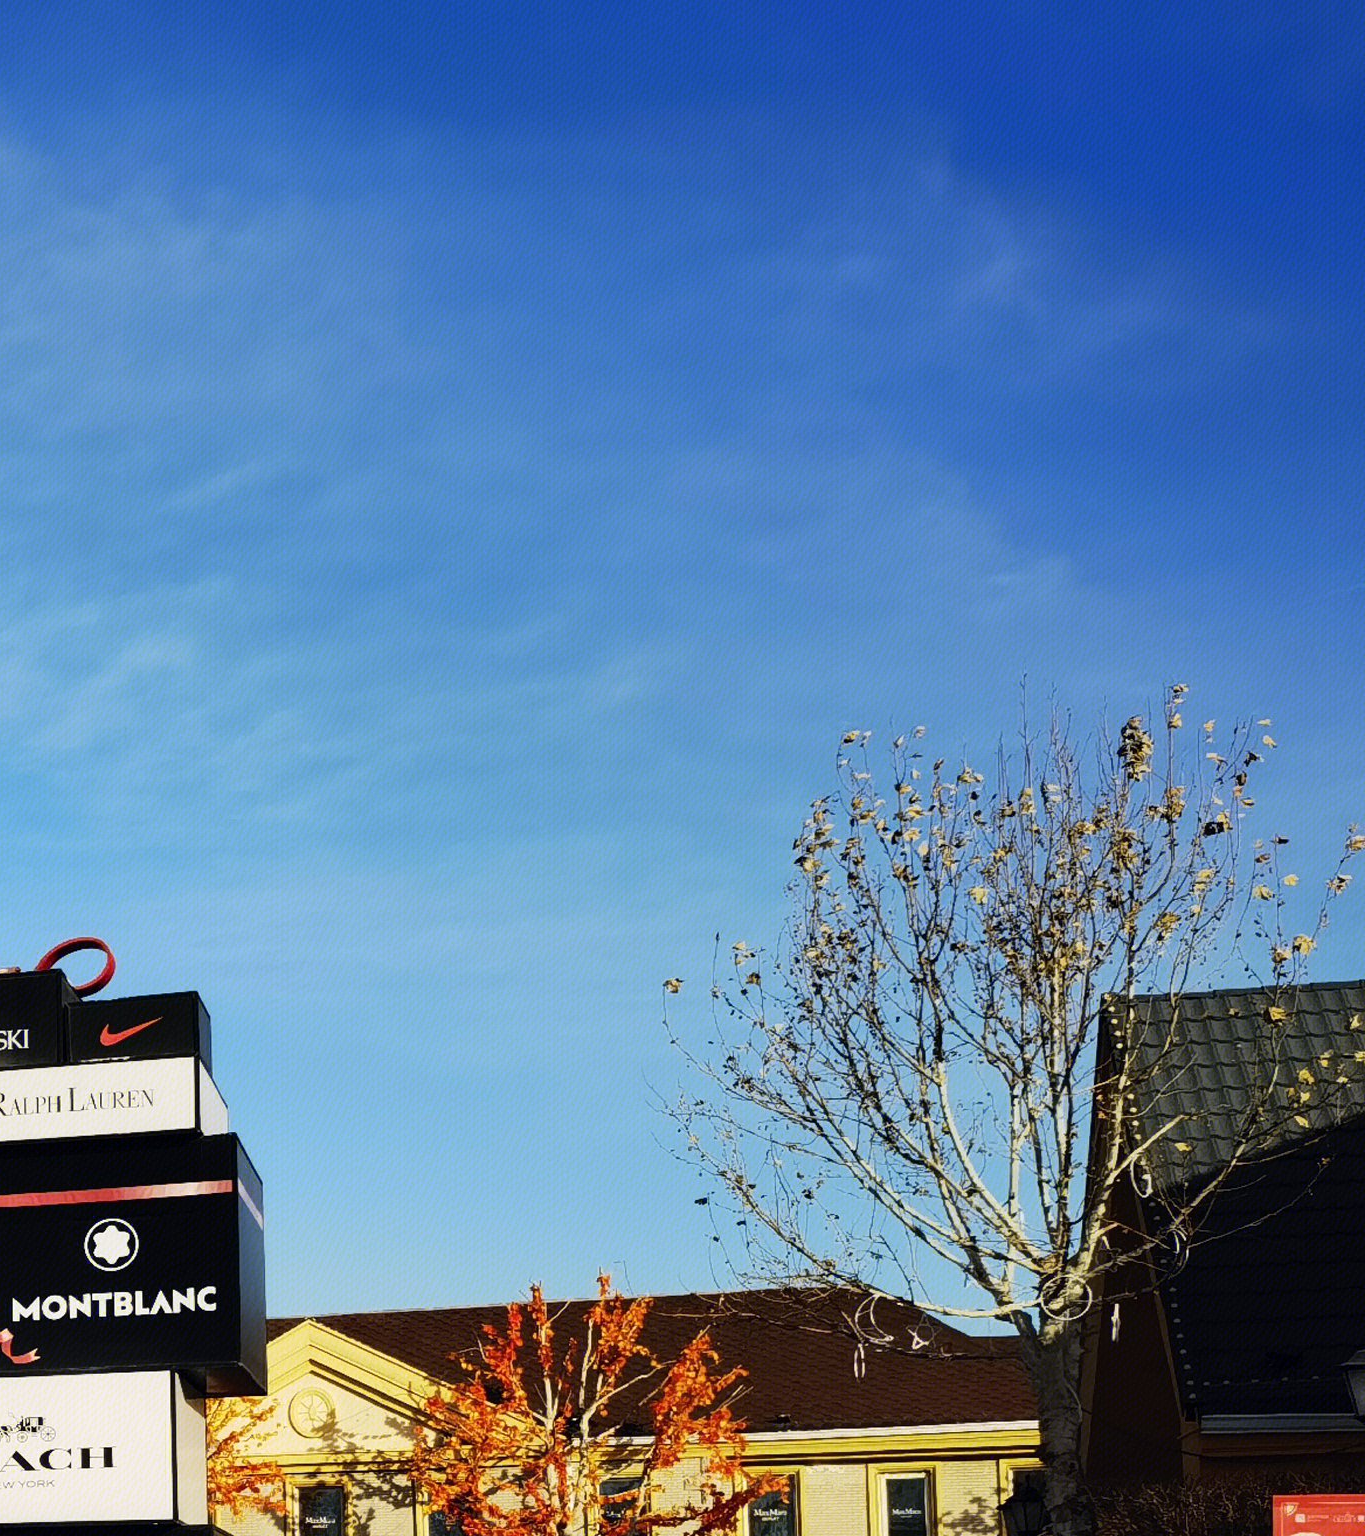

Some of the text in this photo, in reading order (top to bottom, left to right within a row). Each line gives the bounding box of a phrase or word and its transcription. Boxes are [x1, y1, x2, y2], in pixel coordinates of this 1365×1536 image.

[68, 1087, 156, 1113] LAUREN
[11, 1285, 218, 1323] MONTBLANC
[17, 1479, 56, 1491] YORK
